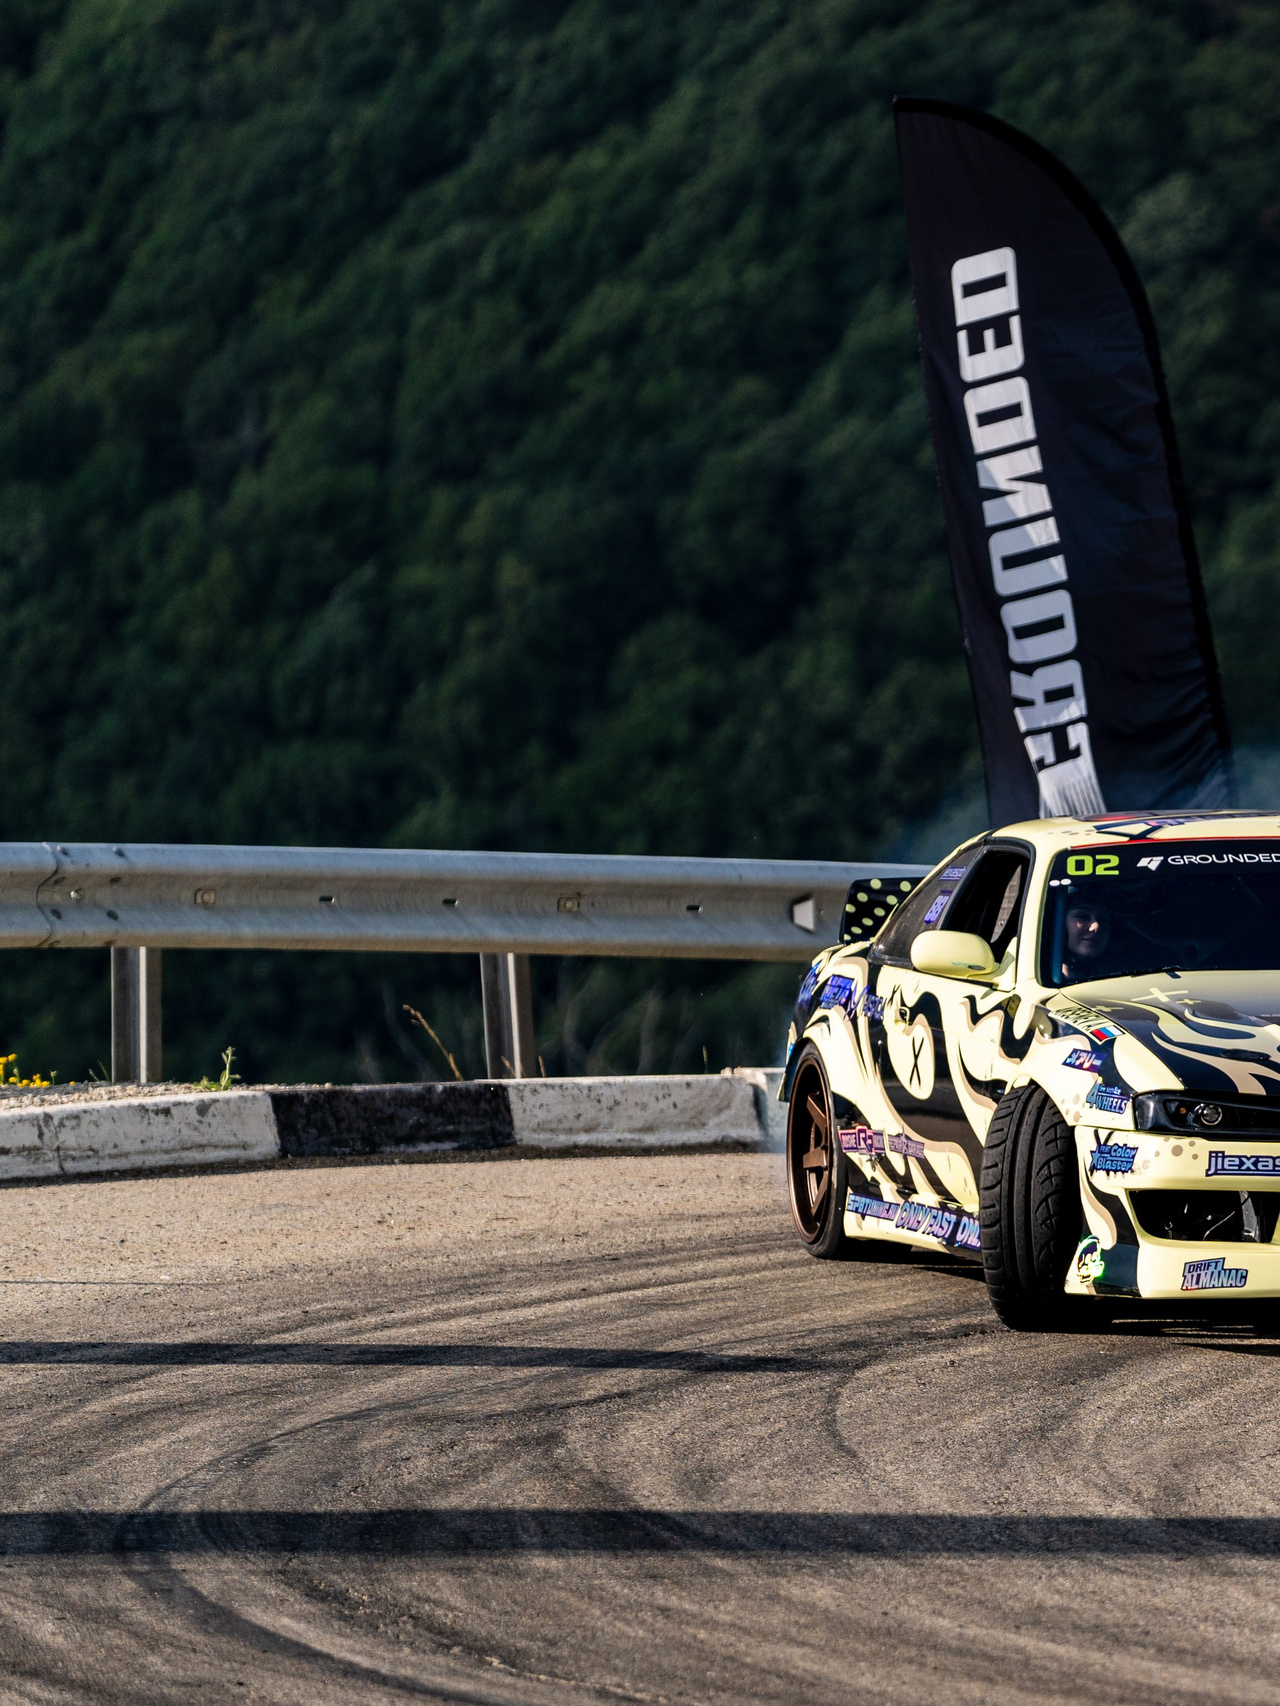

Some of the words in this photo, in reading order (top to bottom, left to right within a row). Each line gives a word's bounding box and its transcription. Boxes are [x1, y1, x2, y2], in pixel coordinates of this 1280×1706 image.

[1066, 854, 1119, 876] 02
[1096, 1095, 1128, 1114] WHEELS
[1111, 1145, 1137, 1158] Color
[1097, 1158, 1132, 1171] Blaster
[896, 1202, 932, 1232] ONLY
[926, 1208, 957, 1238] FAST
[1187, 1260, 1220, 1273] DRIFT
[1182, 1270, 1247, 1290] ALMANAC
